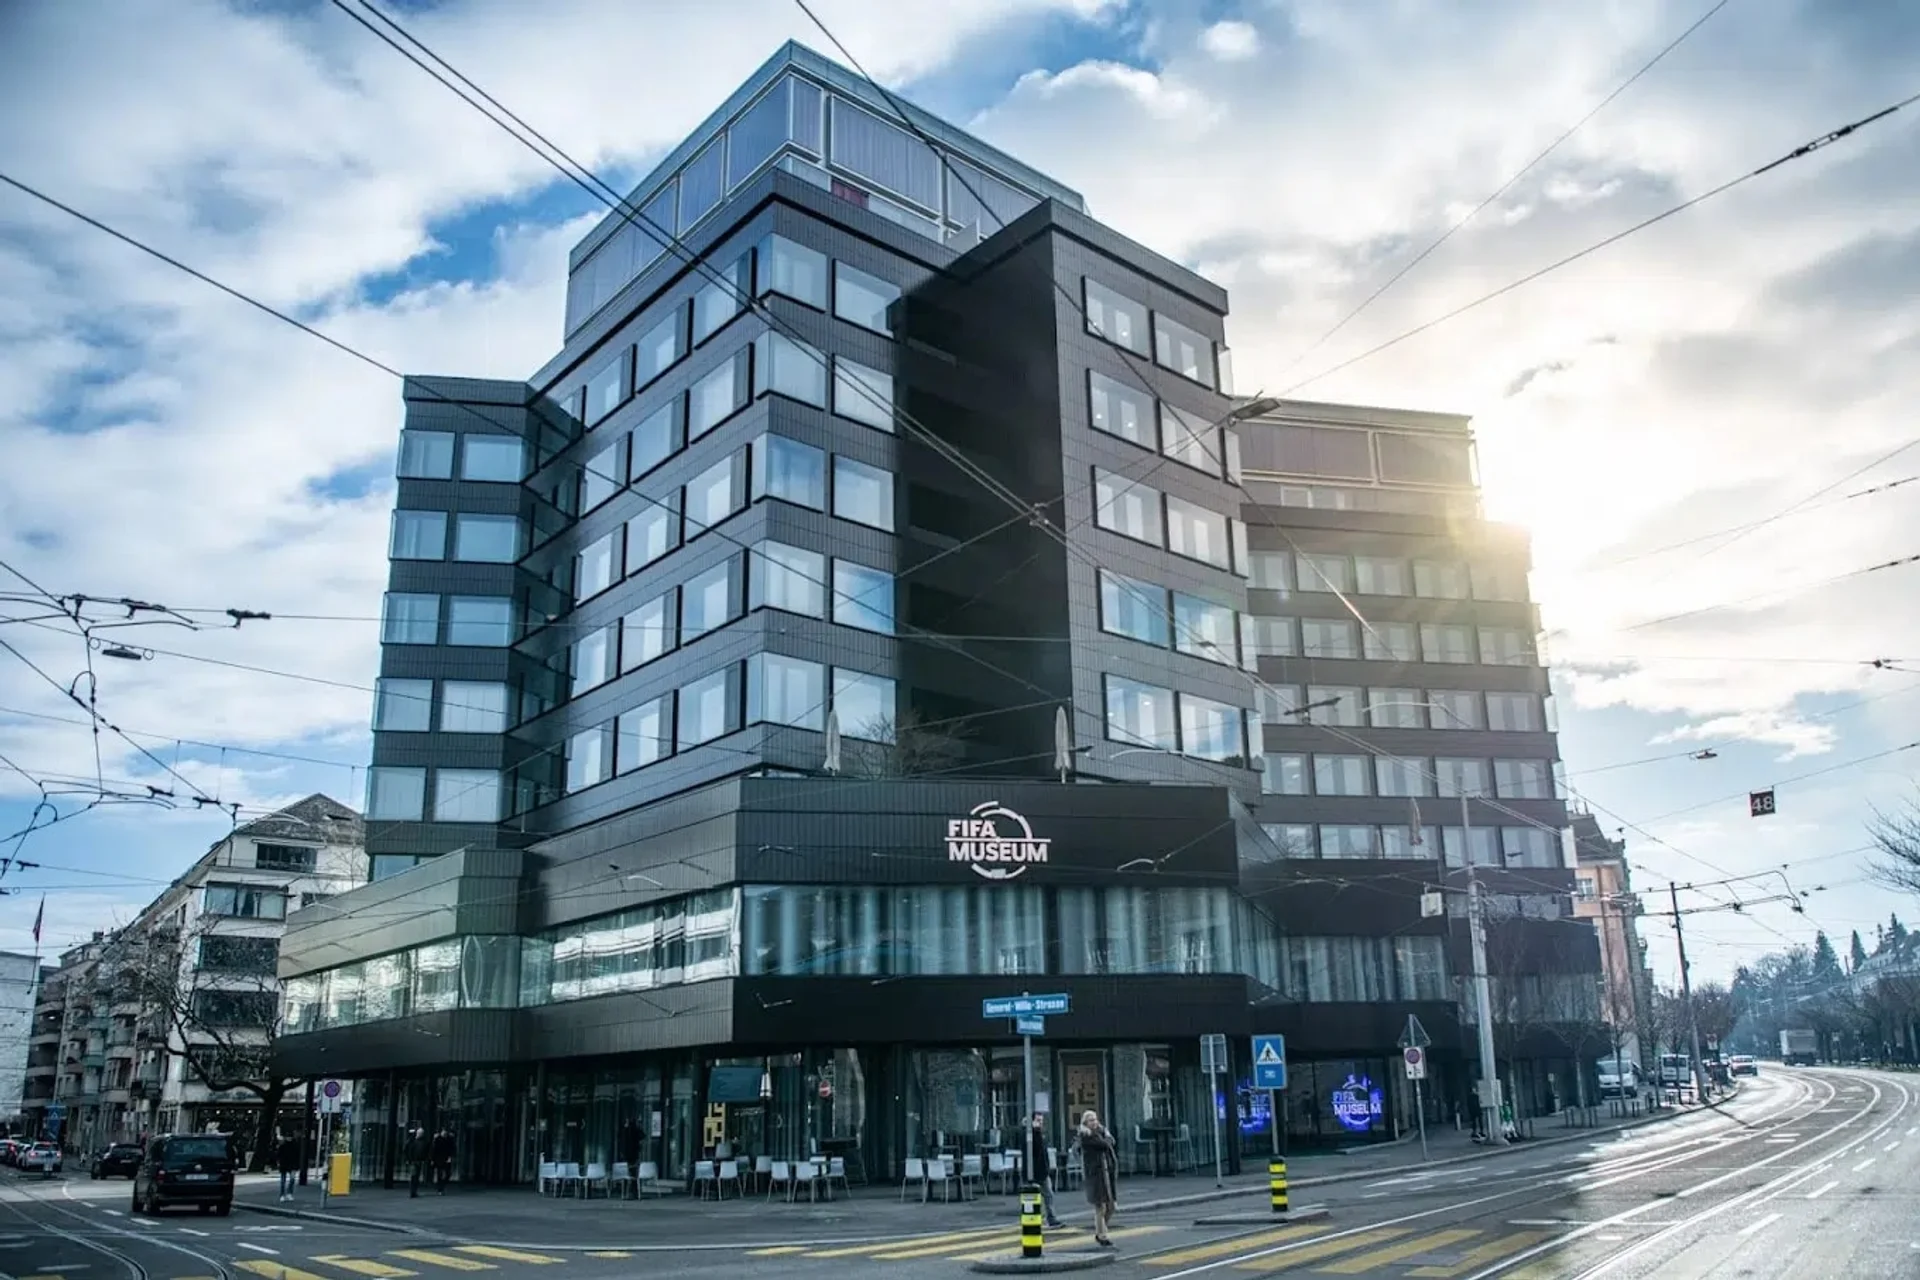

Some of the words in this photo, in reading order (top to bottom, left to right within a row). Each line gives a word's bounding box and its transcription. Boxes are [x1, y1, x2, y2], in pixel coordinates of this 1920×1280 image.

[1752, 796, 1773, 811] 48
[948, 820, 997, 837] FIFA
[949, 842, 1048, 862] MUSEUM
